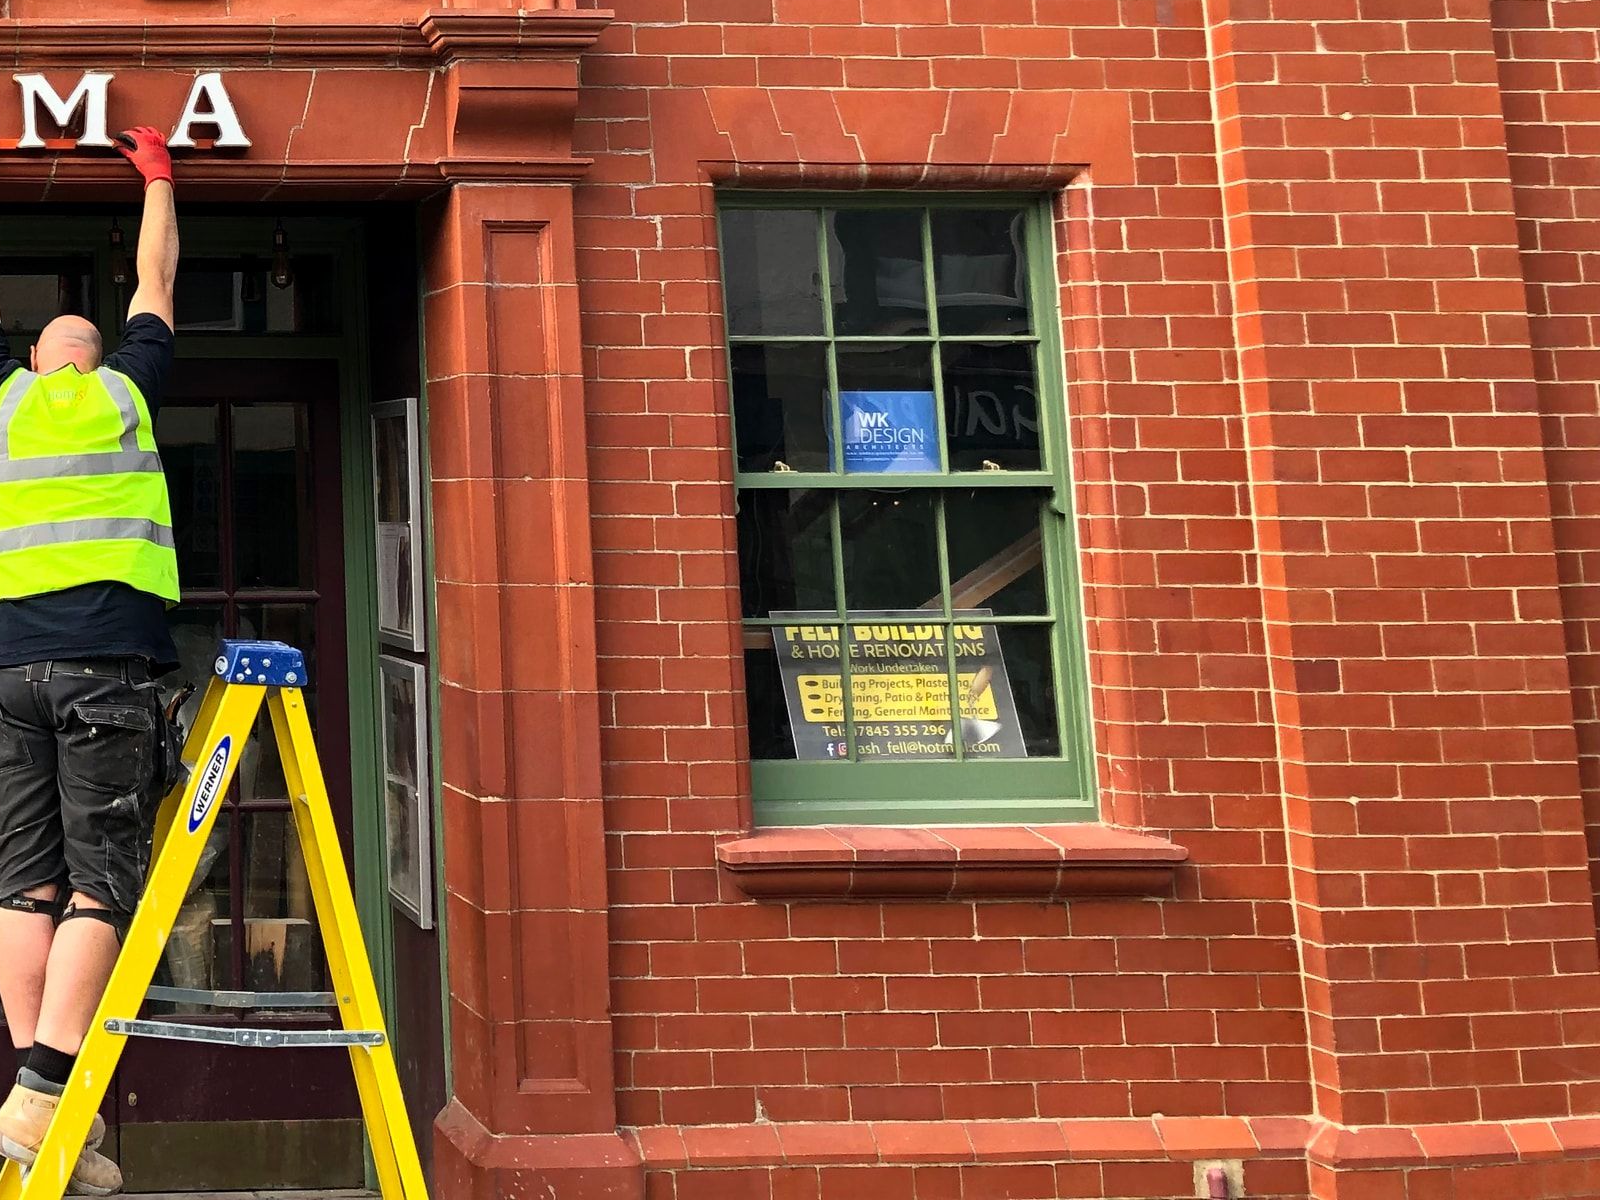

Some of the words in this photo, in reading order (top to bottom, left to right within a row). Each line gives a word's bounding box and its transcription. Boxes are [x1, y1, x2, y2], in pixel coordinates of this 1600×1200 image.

[858, 412, 889, 427] WK
[860, 428, 924, 444] DESIGN
[791, 645, 805, 659] &
[863, 642, 986, 658] RENOVATONS
[876, 662, 939, 673] Undertaken
[868, 678, 914, 690] Projects,
[885, 692, 912, 702] Patio
[914, 691, 924, 701] &
[874, 705, 917, 716] General
[893, 725, 919, 737] 355
[922, 724, 946, 736] 296
[195, 752, 224, 814] WERNER
